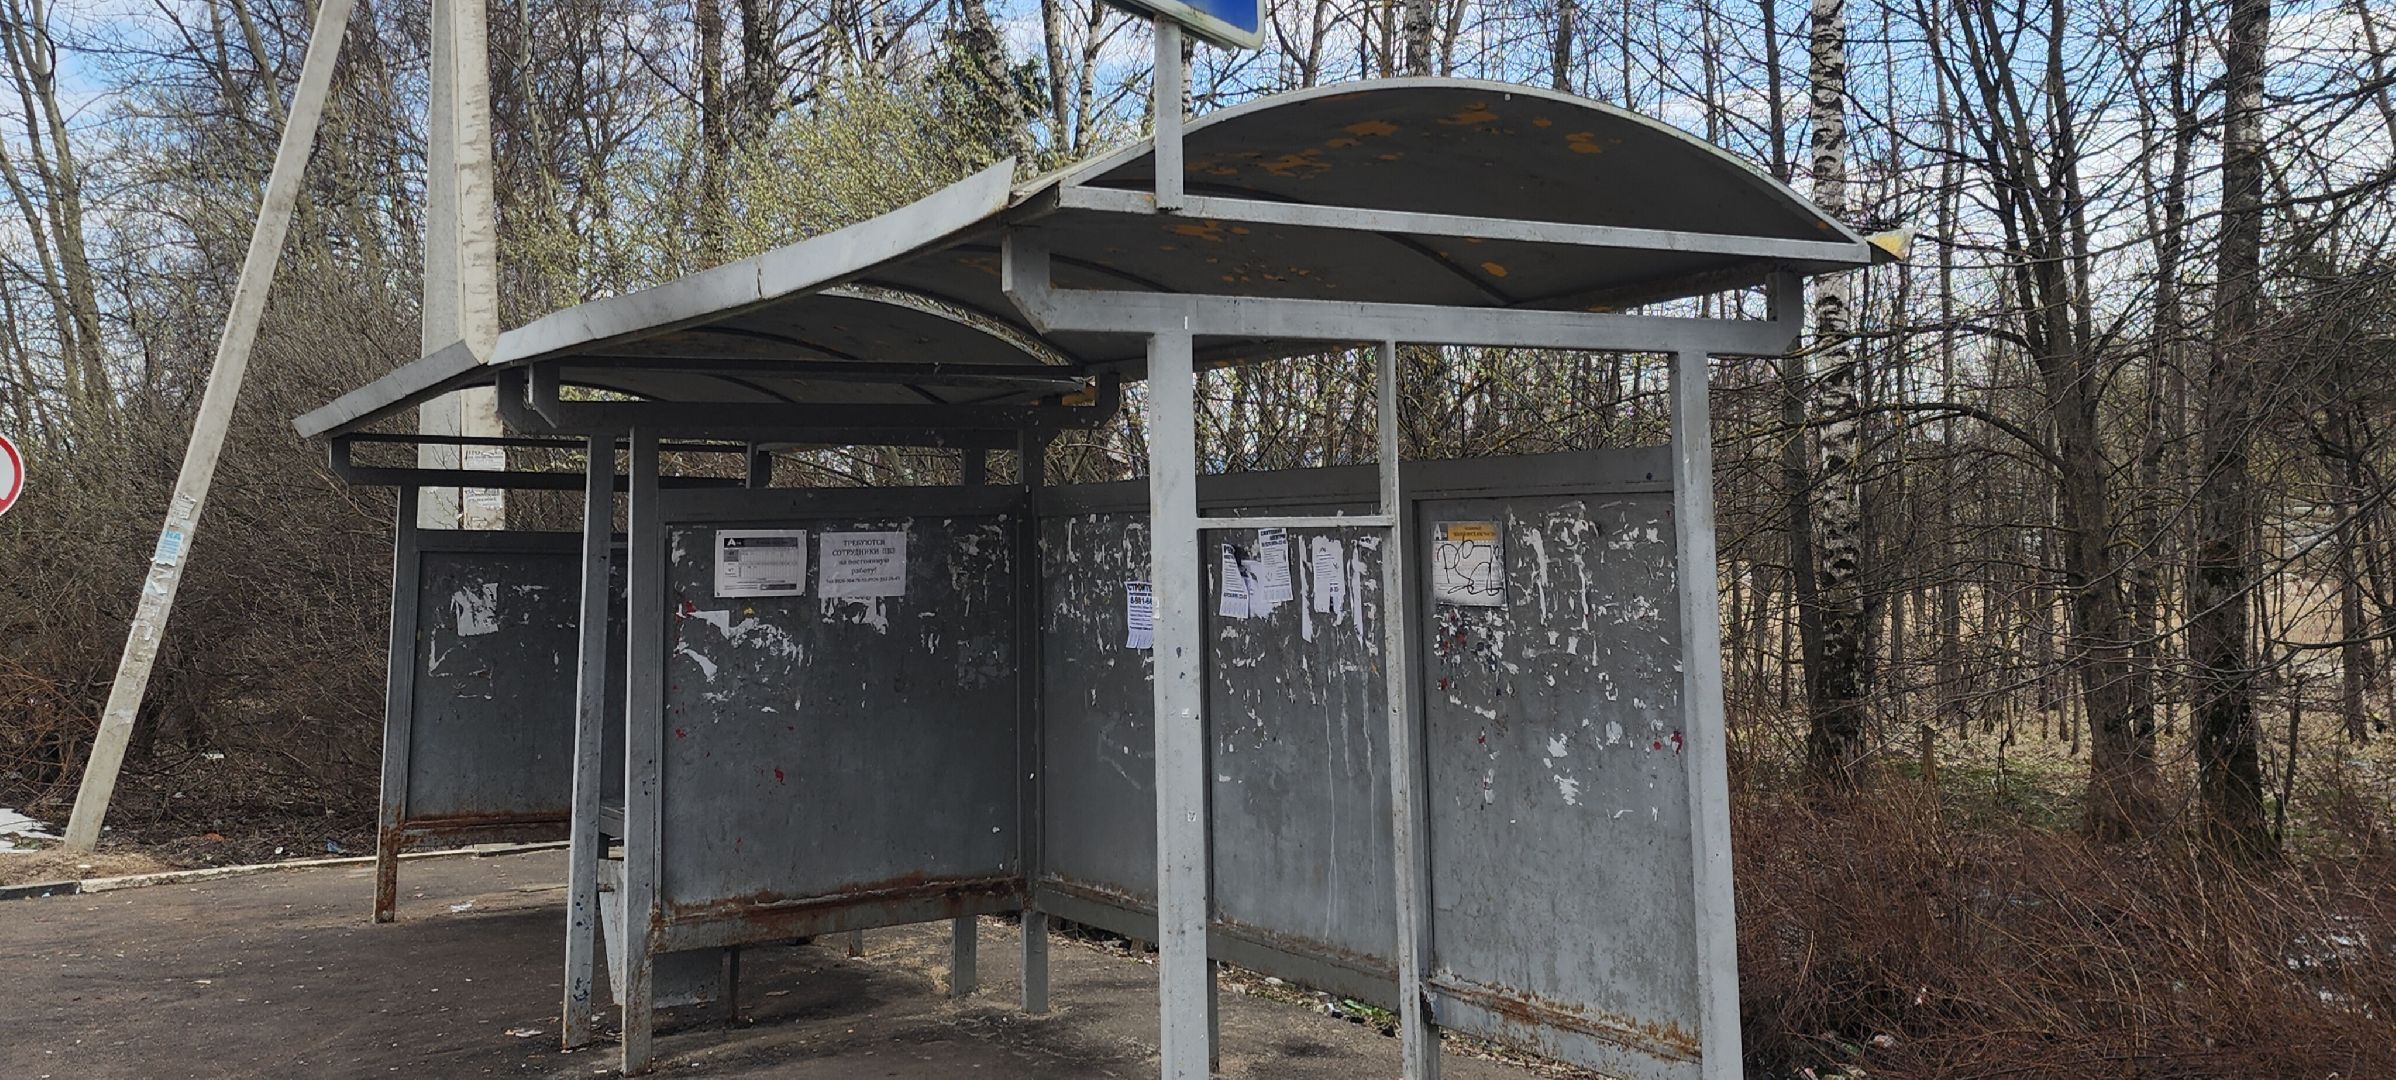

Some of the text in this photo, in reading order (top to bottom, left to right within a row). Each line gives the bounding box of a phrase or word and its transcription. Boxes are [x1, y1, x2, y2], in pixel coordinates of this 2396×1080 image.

[843, 539, 886, 547] ТРЕБУЮТСЯ
[831, 548, 880, 557] СОТРУДНИКИ
[848, 558, 890, 566] постоянную
[1127, 583, 1152, 592] СТРОИТЕ
